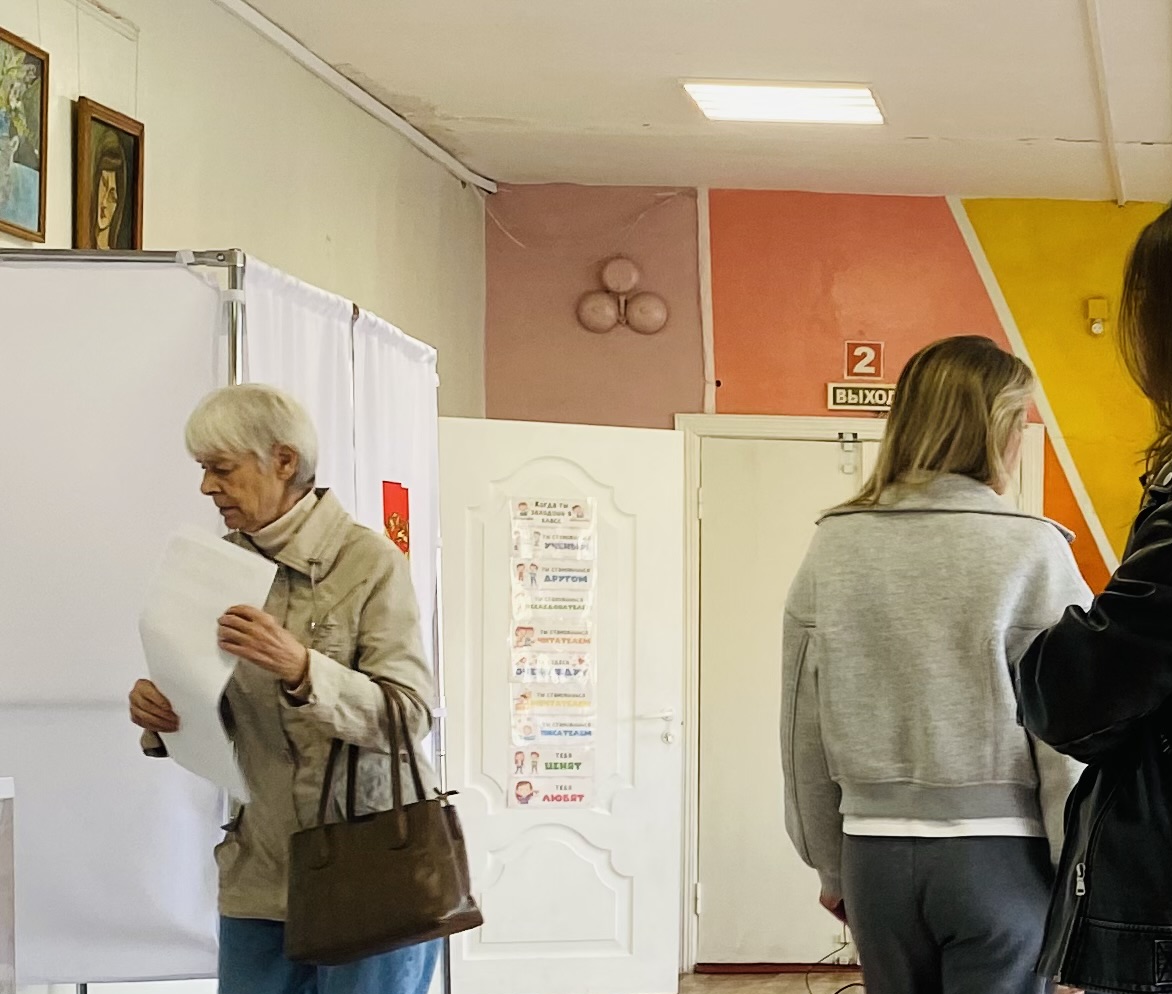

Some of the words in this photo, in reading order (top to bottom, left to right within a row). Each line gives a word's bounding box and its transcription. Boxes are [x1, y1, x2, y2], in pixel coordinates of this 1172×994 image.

[853, 346, 876, 374] 2
[544, 575, 588, 583] ДРУГОМ
[544, 762, 582, 770] ЦЕНЯТ
[542, 793, 585, 803] ЛЮБЯТ
